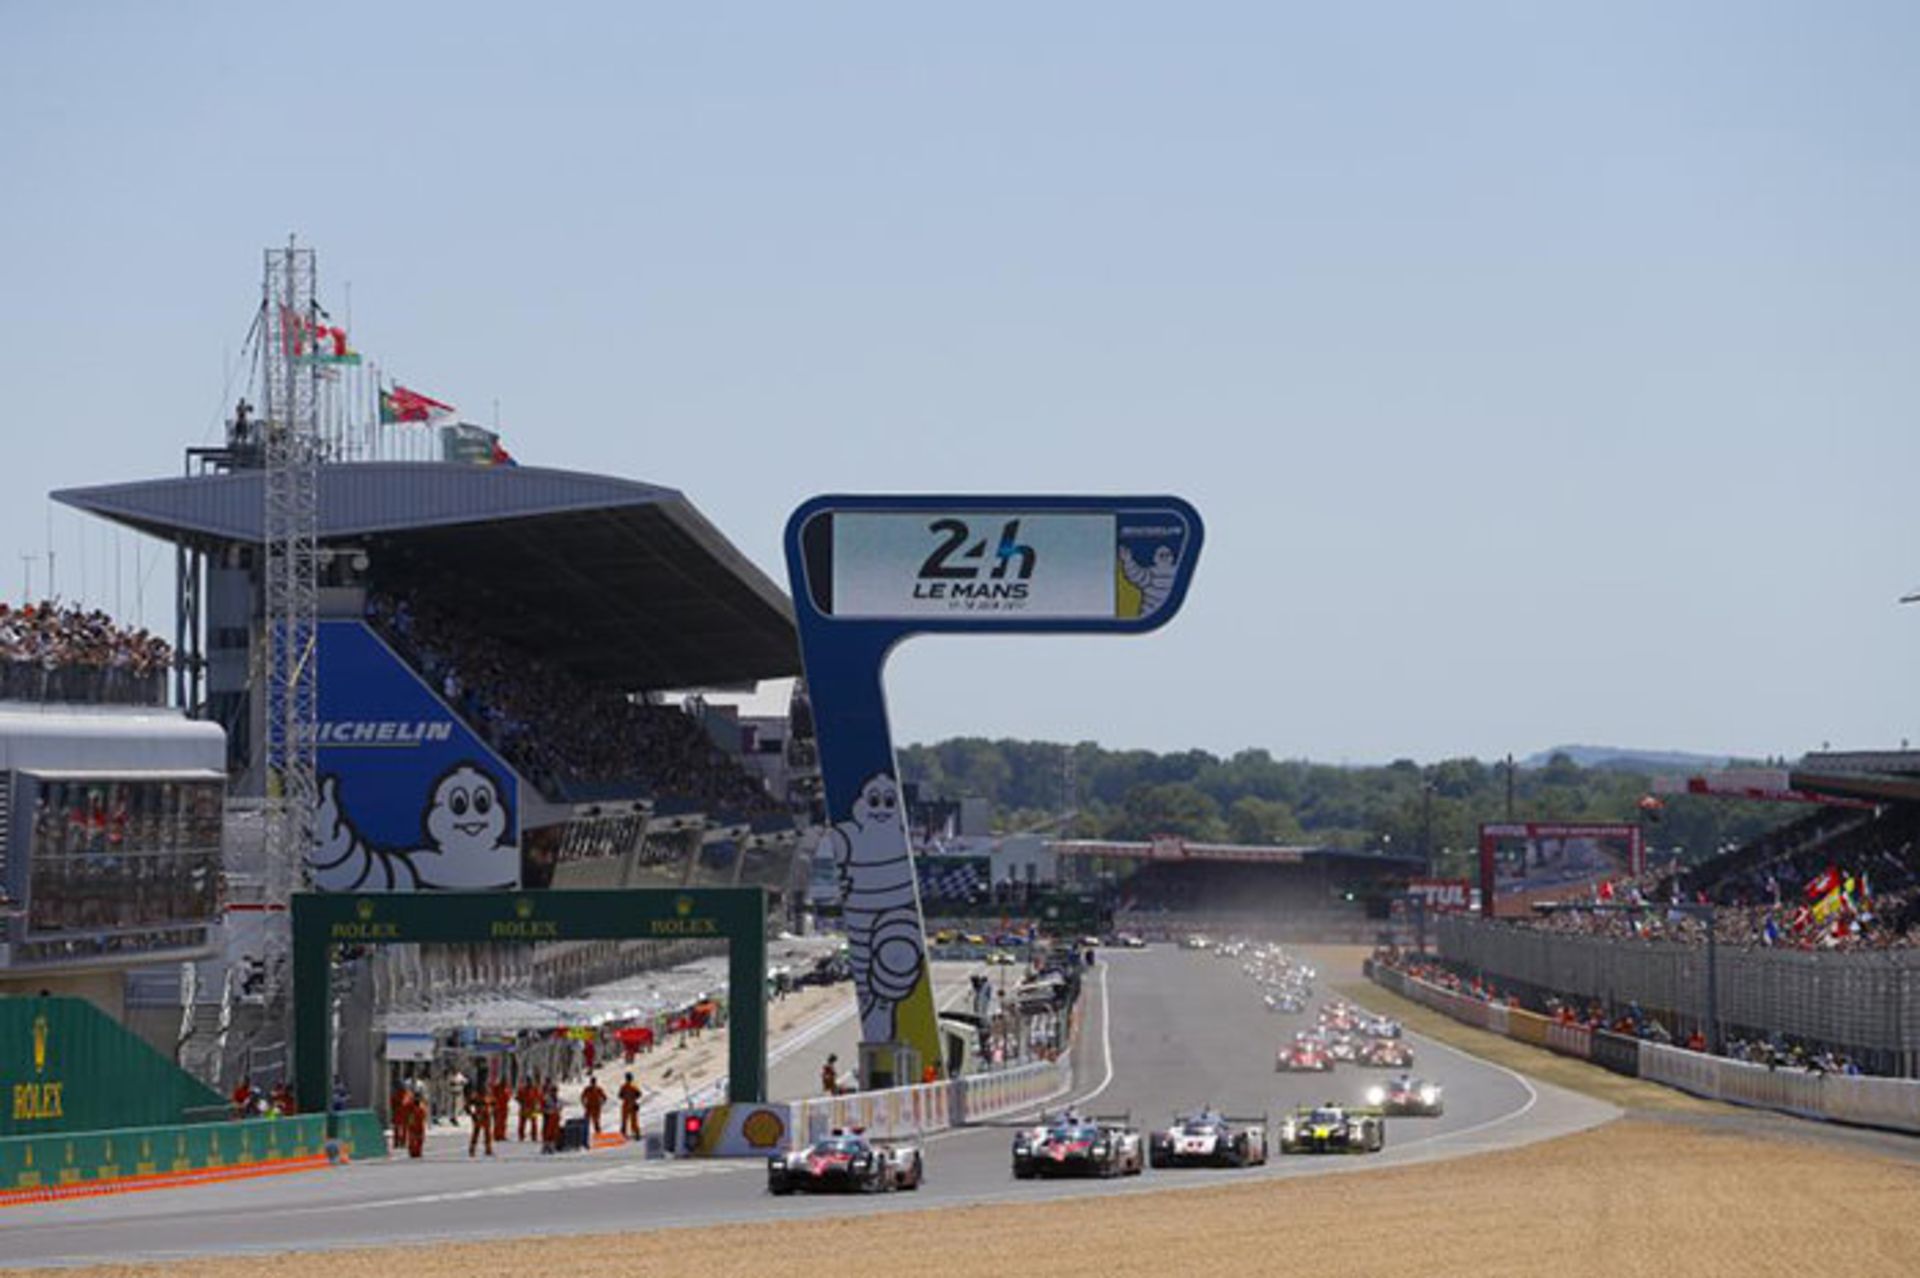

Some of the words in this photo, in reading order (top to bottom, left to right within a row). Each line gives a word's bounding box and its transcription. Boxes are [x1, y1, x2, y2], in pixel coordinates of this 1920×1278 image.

[912, 583, 947, 599] LE
[951, 583, 1029, 599] MANS
[331, 922, 399, 938] ROLEX
[490, 920, 558, 936] ROLEX
[650, 918, 719, 934] ROLEX
[12, 1082, 64, 1119] ROLEX
